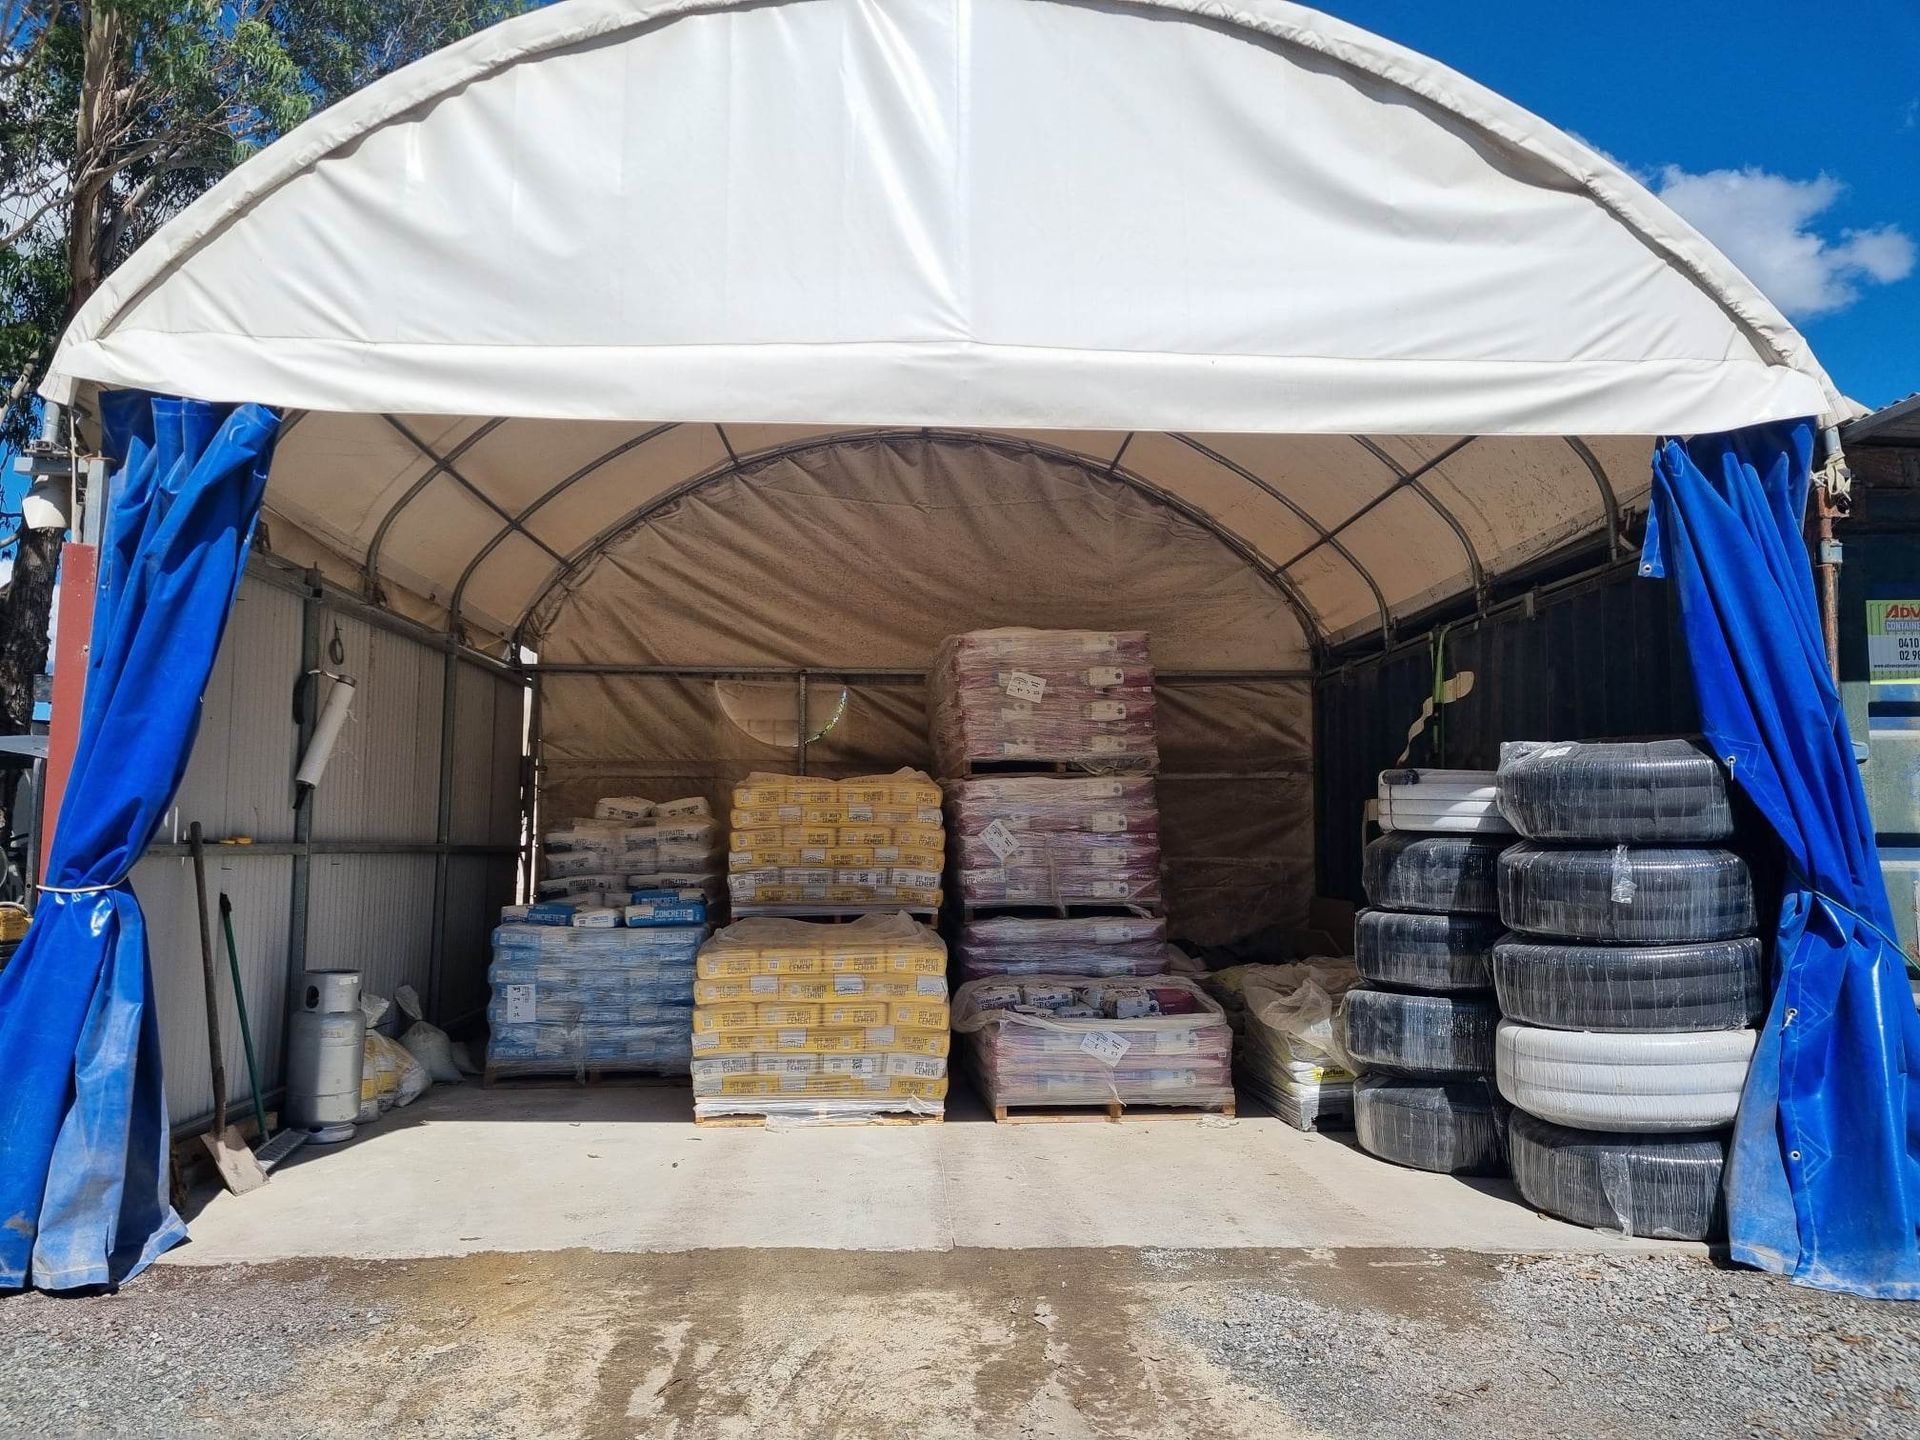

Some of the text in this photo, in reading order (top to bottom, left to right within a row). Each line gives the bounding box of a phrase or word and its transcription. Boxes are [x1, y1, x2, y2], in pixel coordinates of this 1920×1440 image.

[1898, 637, 1919, 648] 0410
[1899, 651, 1910, 661] 02
[528, 912, 560, 924] CONCRETE
[655, 909, 687, 918] CONCRETE
[915, 963, 938, 971] CEMENT
[917, 1017, 942, 1026] CEMENT
[914, 1067, 938, 1076] CEMENT
